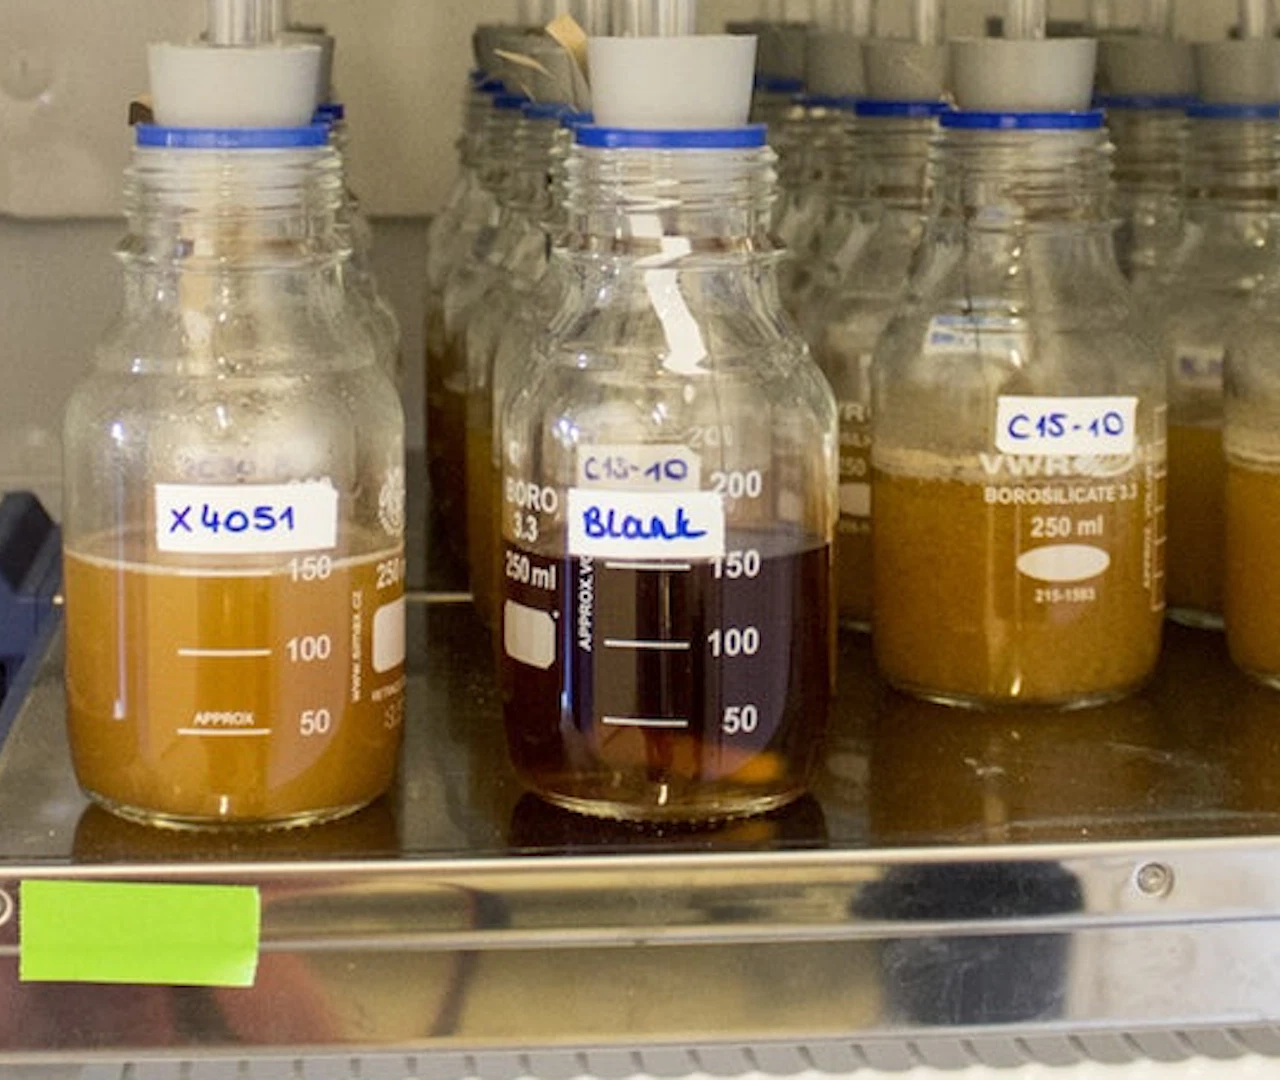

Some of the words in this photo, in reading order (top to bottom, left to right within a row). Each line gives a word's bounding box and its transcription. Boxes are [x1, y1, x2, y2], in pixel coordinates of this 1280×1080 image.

[1007, 411, 1124, 439] C15-10
[506, 476, 558, 514] BORO
[710, 471, 762, 498] 200
[983, 485, 1116, 505] BOROSILICATE
[169, 503, 295, 533] X4051
[513, 511, 539, 543] 3.3
[582, 505, 709, 540] Blank
[1030, 516, 1070, 538] 250
[1077, 514, 1104, 536] ml
[288, 555, 332, 582] 150
[505, 550, 530, 583] 250
[531, 563, 557, 591] ml
[708, 549, 760, 579] 150
[286, 635, 332, 663] 100
[706, 628, 760, 657] 100
[193, 711, 255, 727] APPROX
[300, 709, 331, 736] 50
[722, 705, 759, 734] 50
